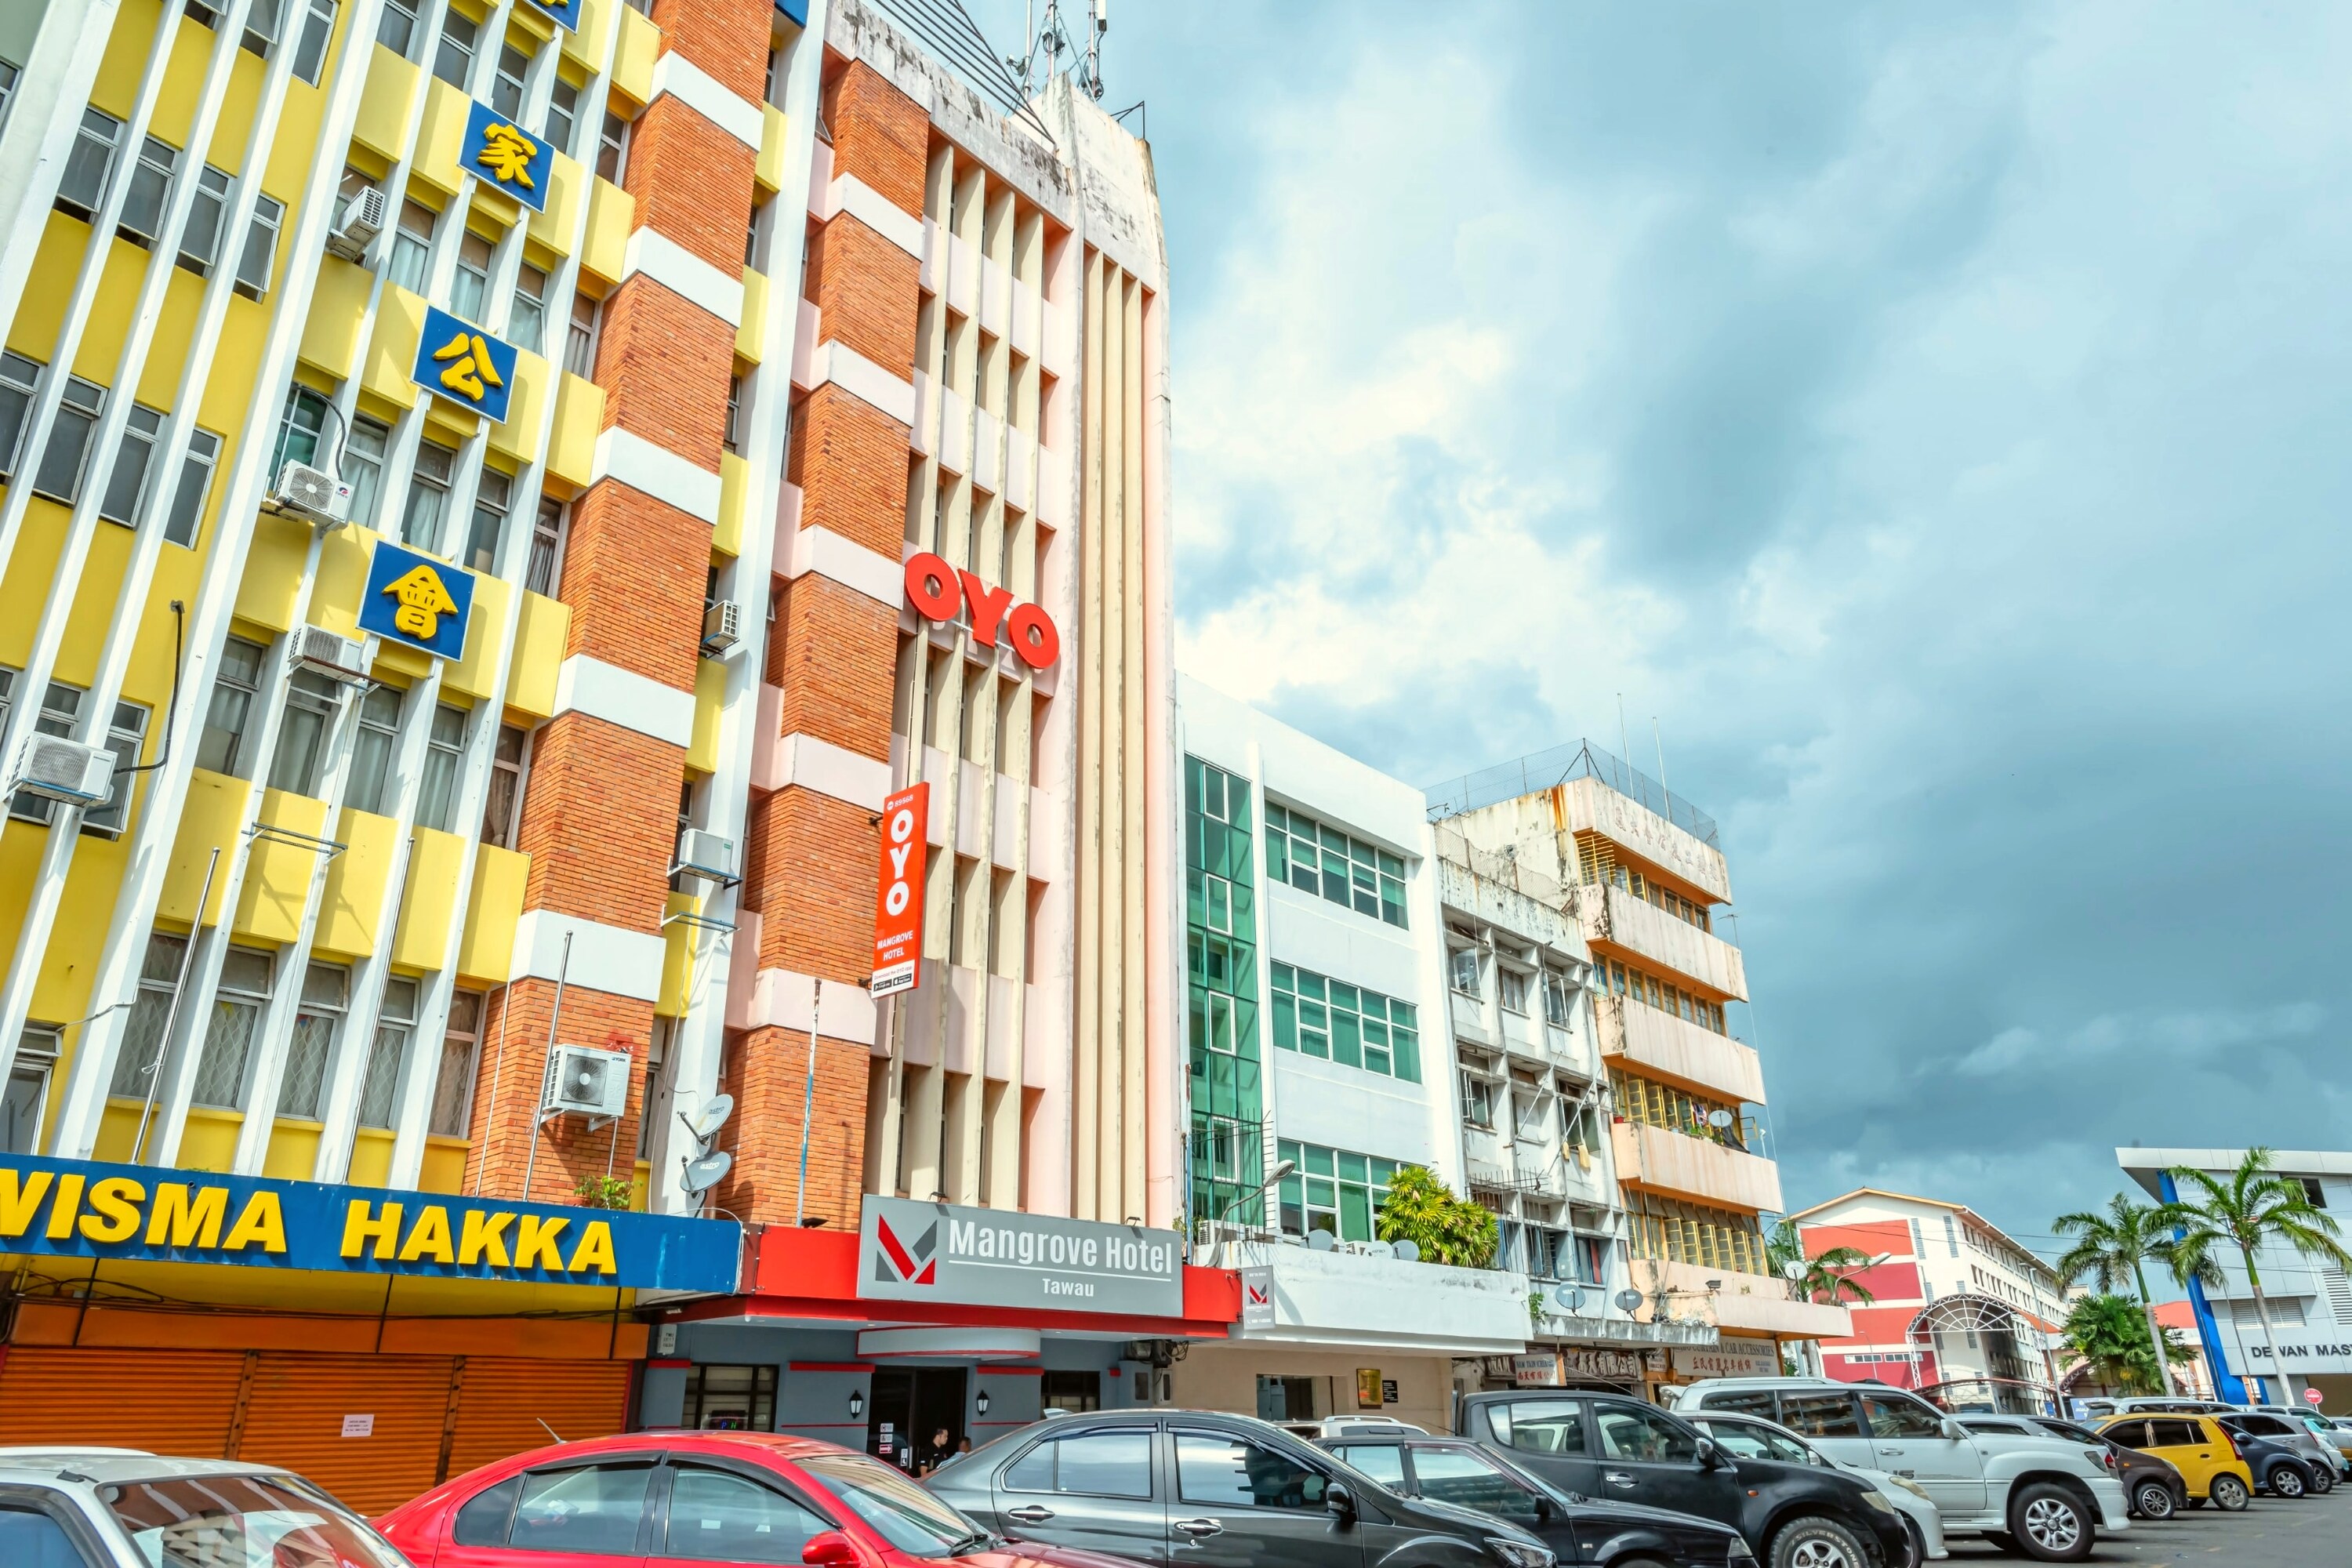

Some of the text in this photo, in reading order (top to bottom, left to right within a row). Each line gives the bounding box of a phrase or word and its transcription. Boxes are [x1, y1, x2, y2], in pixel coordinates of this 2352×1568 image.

[905, 552, 1060, 669] OYO
[886, 809, 913, 916] OYO
[877, 930, 913, 950] MANGROVE
[883, 946, 905, 961] HOTEL
[340, 1200, 617, 1274] HAKKA
[949, 1219, 1171, 1273] Mangrove Hotel
[1042, 1278, 1094, 1297] Tawau
[2315, 1344, 2352, 1356] MAS
[1796, 1530, 1861, 1568] SILVERSTONE
